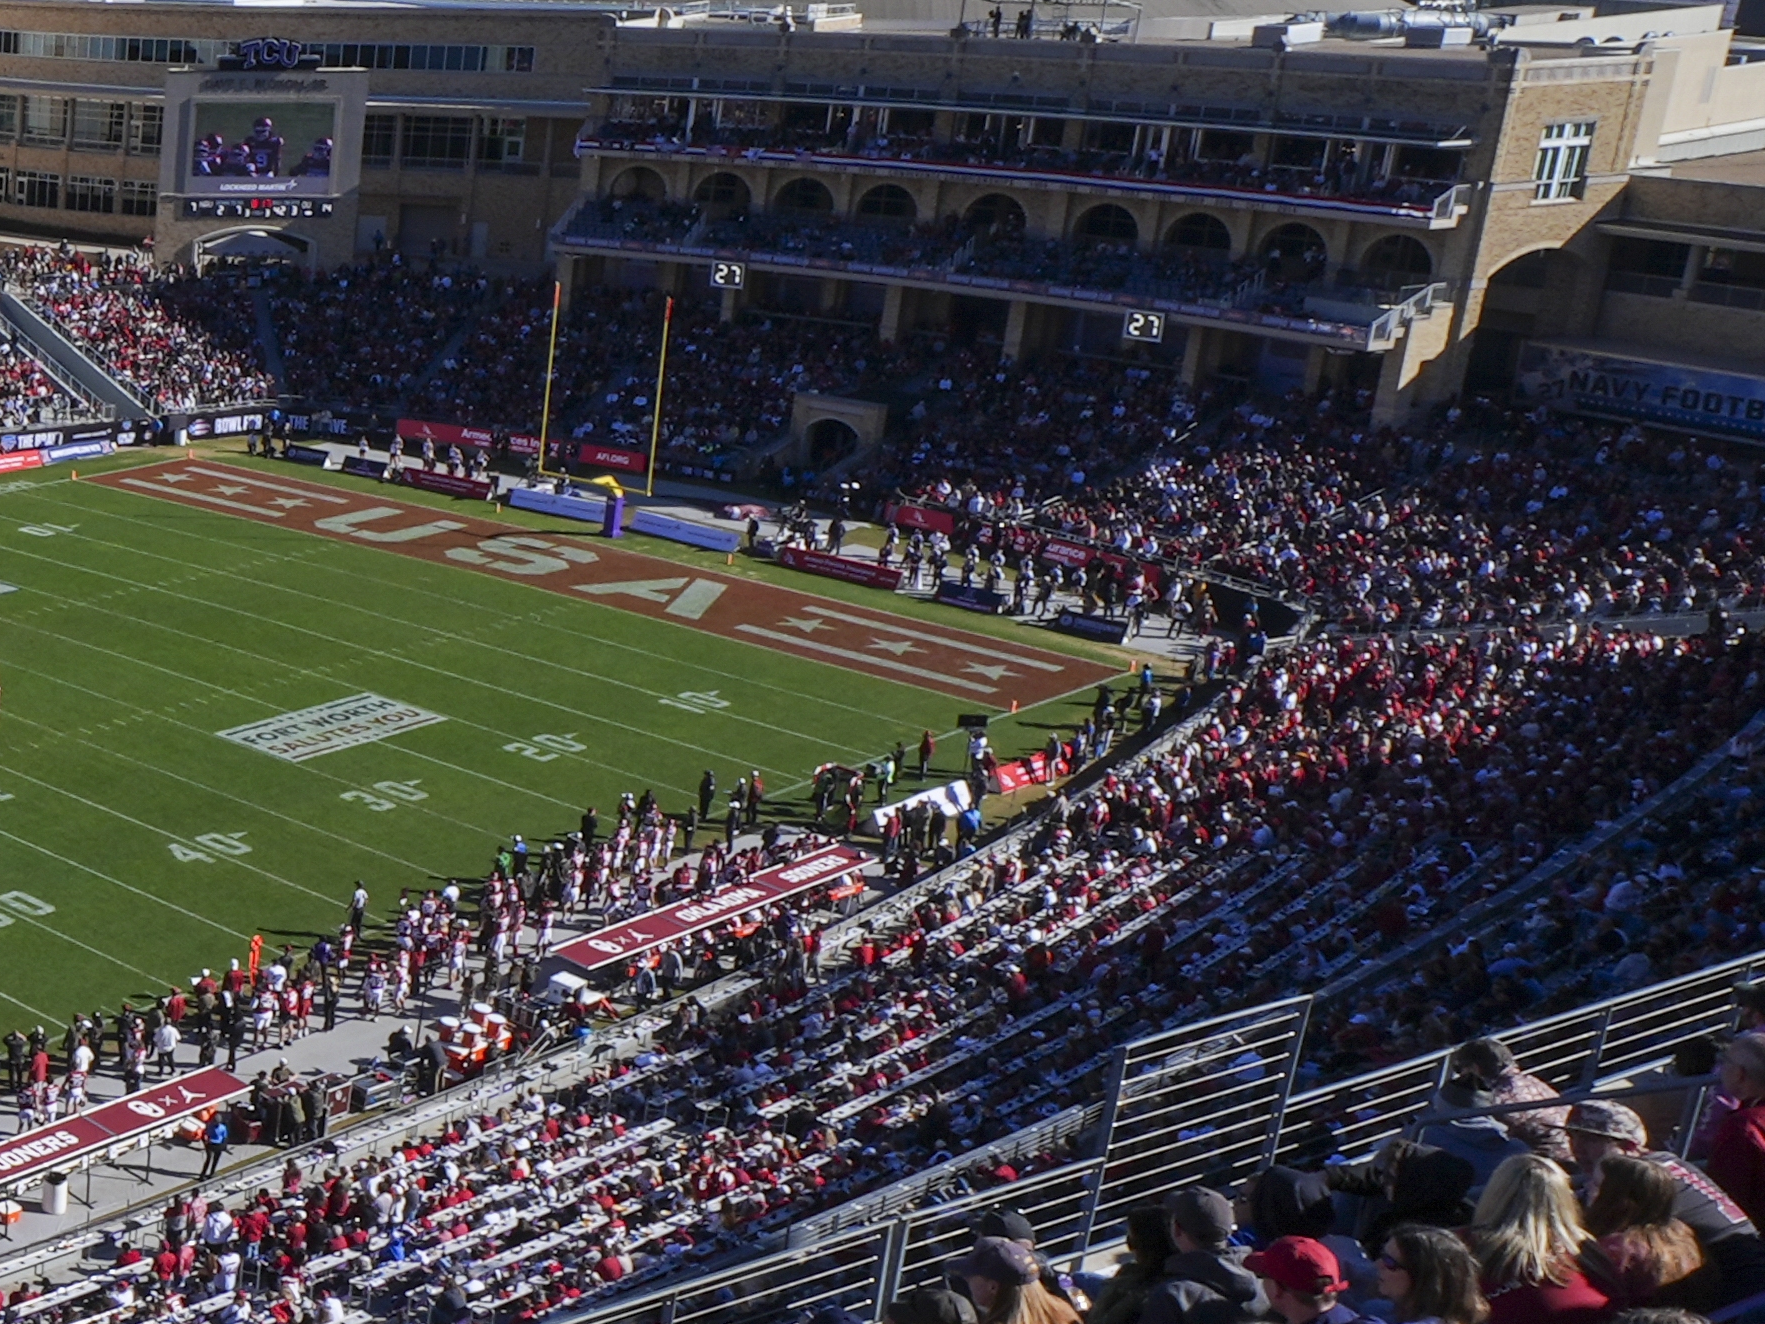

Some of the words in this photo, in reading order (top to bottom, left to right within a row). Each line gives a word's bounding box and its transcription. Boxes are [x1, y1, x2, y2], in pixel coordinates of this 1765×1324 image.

[240, 38, 302, 69] TCU
[714, 263, 742, 285] 27
[1128, 312, 1161, 337] 27
[1569, 369, 1652, 402] NAVY
[288, 415, 309, 431] THE
[314, 506, 729, 620] USA
[241, 721, 312, 747] FORT
[307, 699, 398, 730] WORTH
[267, 723, 370, 755] SALUTES
[368, 708, 422, 731] YOU
[502, 733, 588, 763] 20
[339, 780, 430, 812] 30
[167, 831, 253, 866] 40
[777, 854, 851, 884] SOONERS
[675, 887, 767, 923] OKLAHOMA
